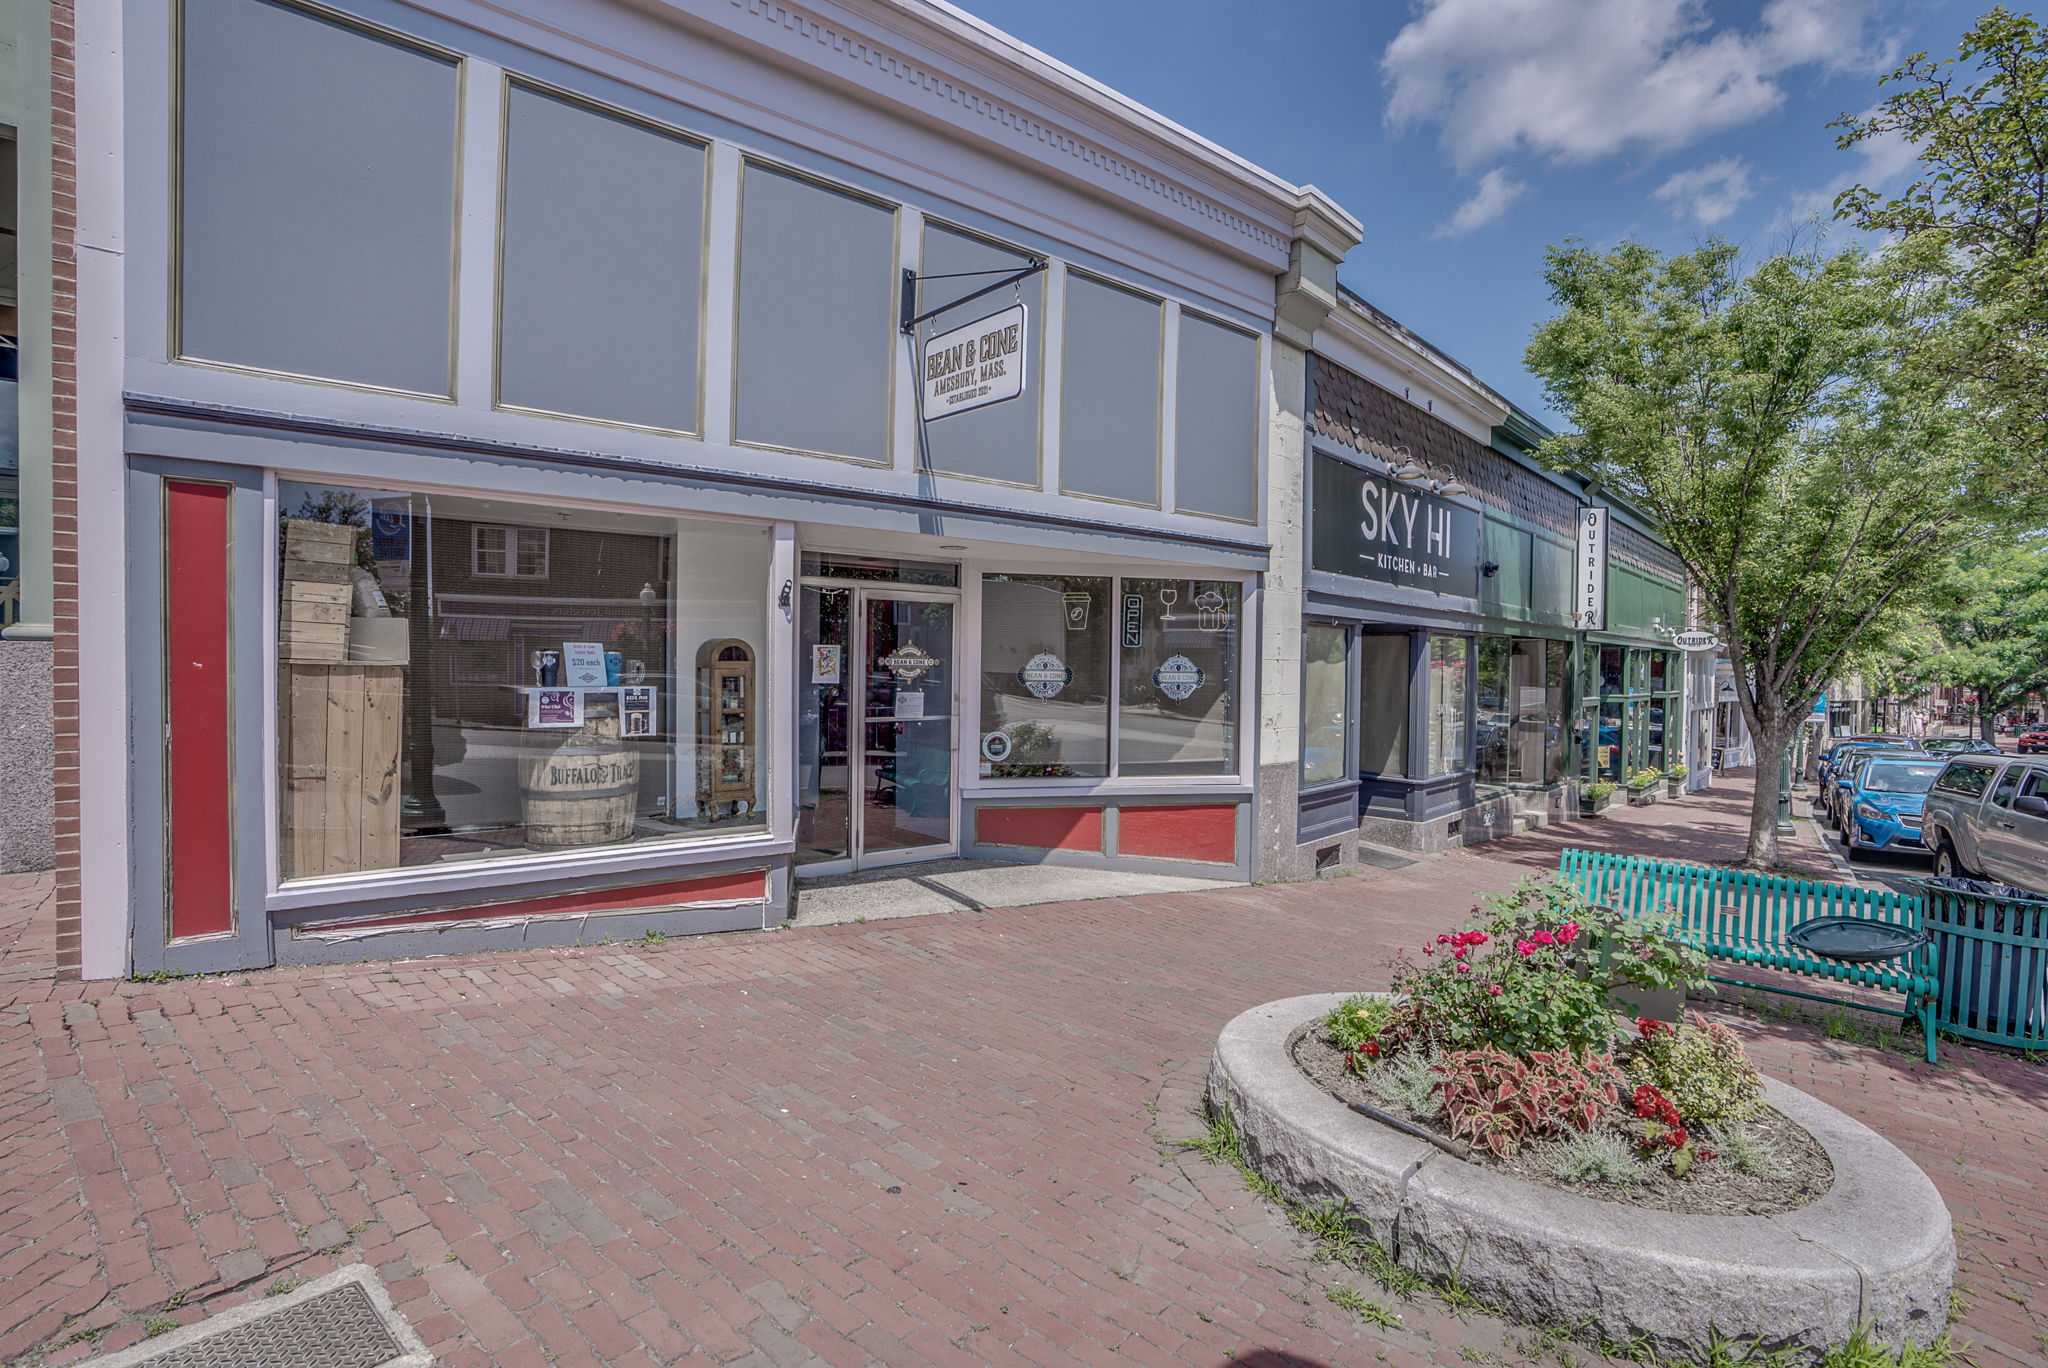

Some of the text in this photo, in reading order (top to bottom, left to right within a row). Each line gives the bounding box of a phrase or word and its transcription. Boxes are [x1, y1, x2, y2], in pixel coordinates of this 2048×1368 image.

[927, 324, 1018, 381] BEAN & CONE
[934, 360, 1006, 397] AMESBURY, MASS.
[1361, 480, 1451, 559] SKY HI
[1378, 553, 1438, 578] KITCHEN BAR
[1585, 512, 1597, 625] OUTRIDER
[1126, 598, 1140, 645] OPEN
[551, 766, 597, 785] BUFFALO
